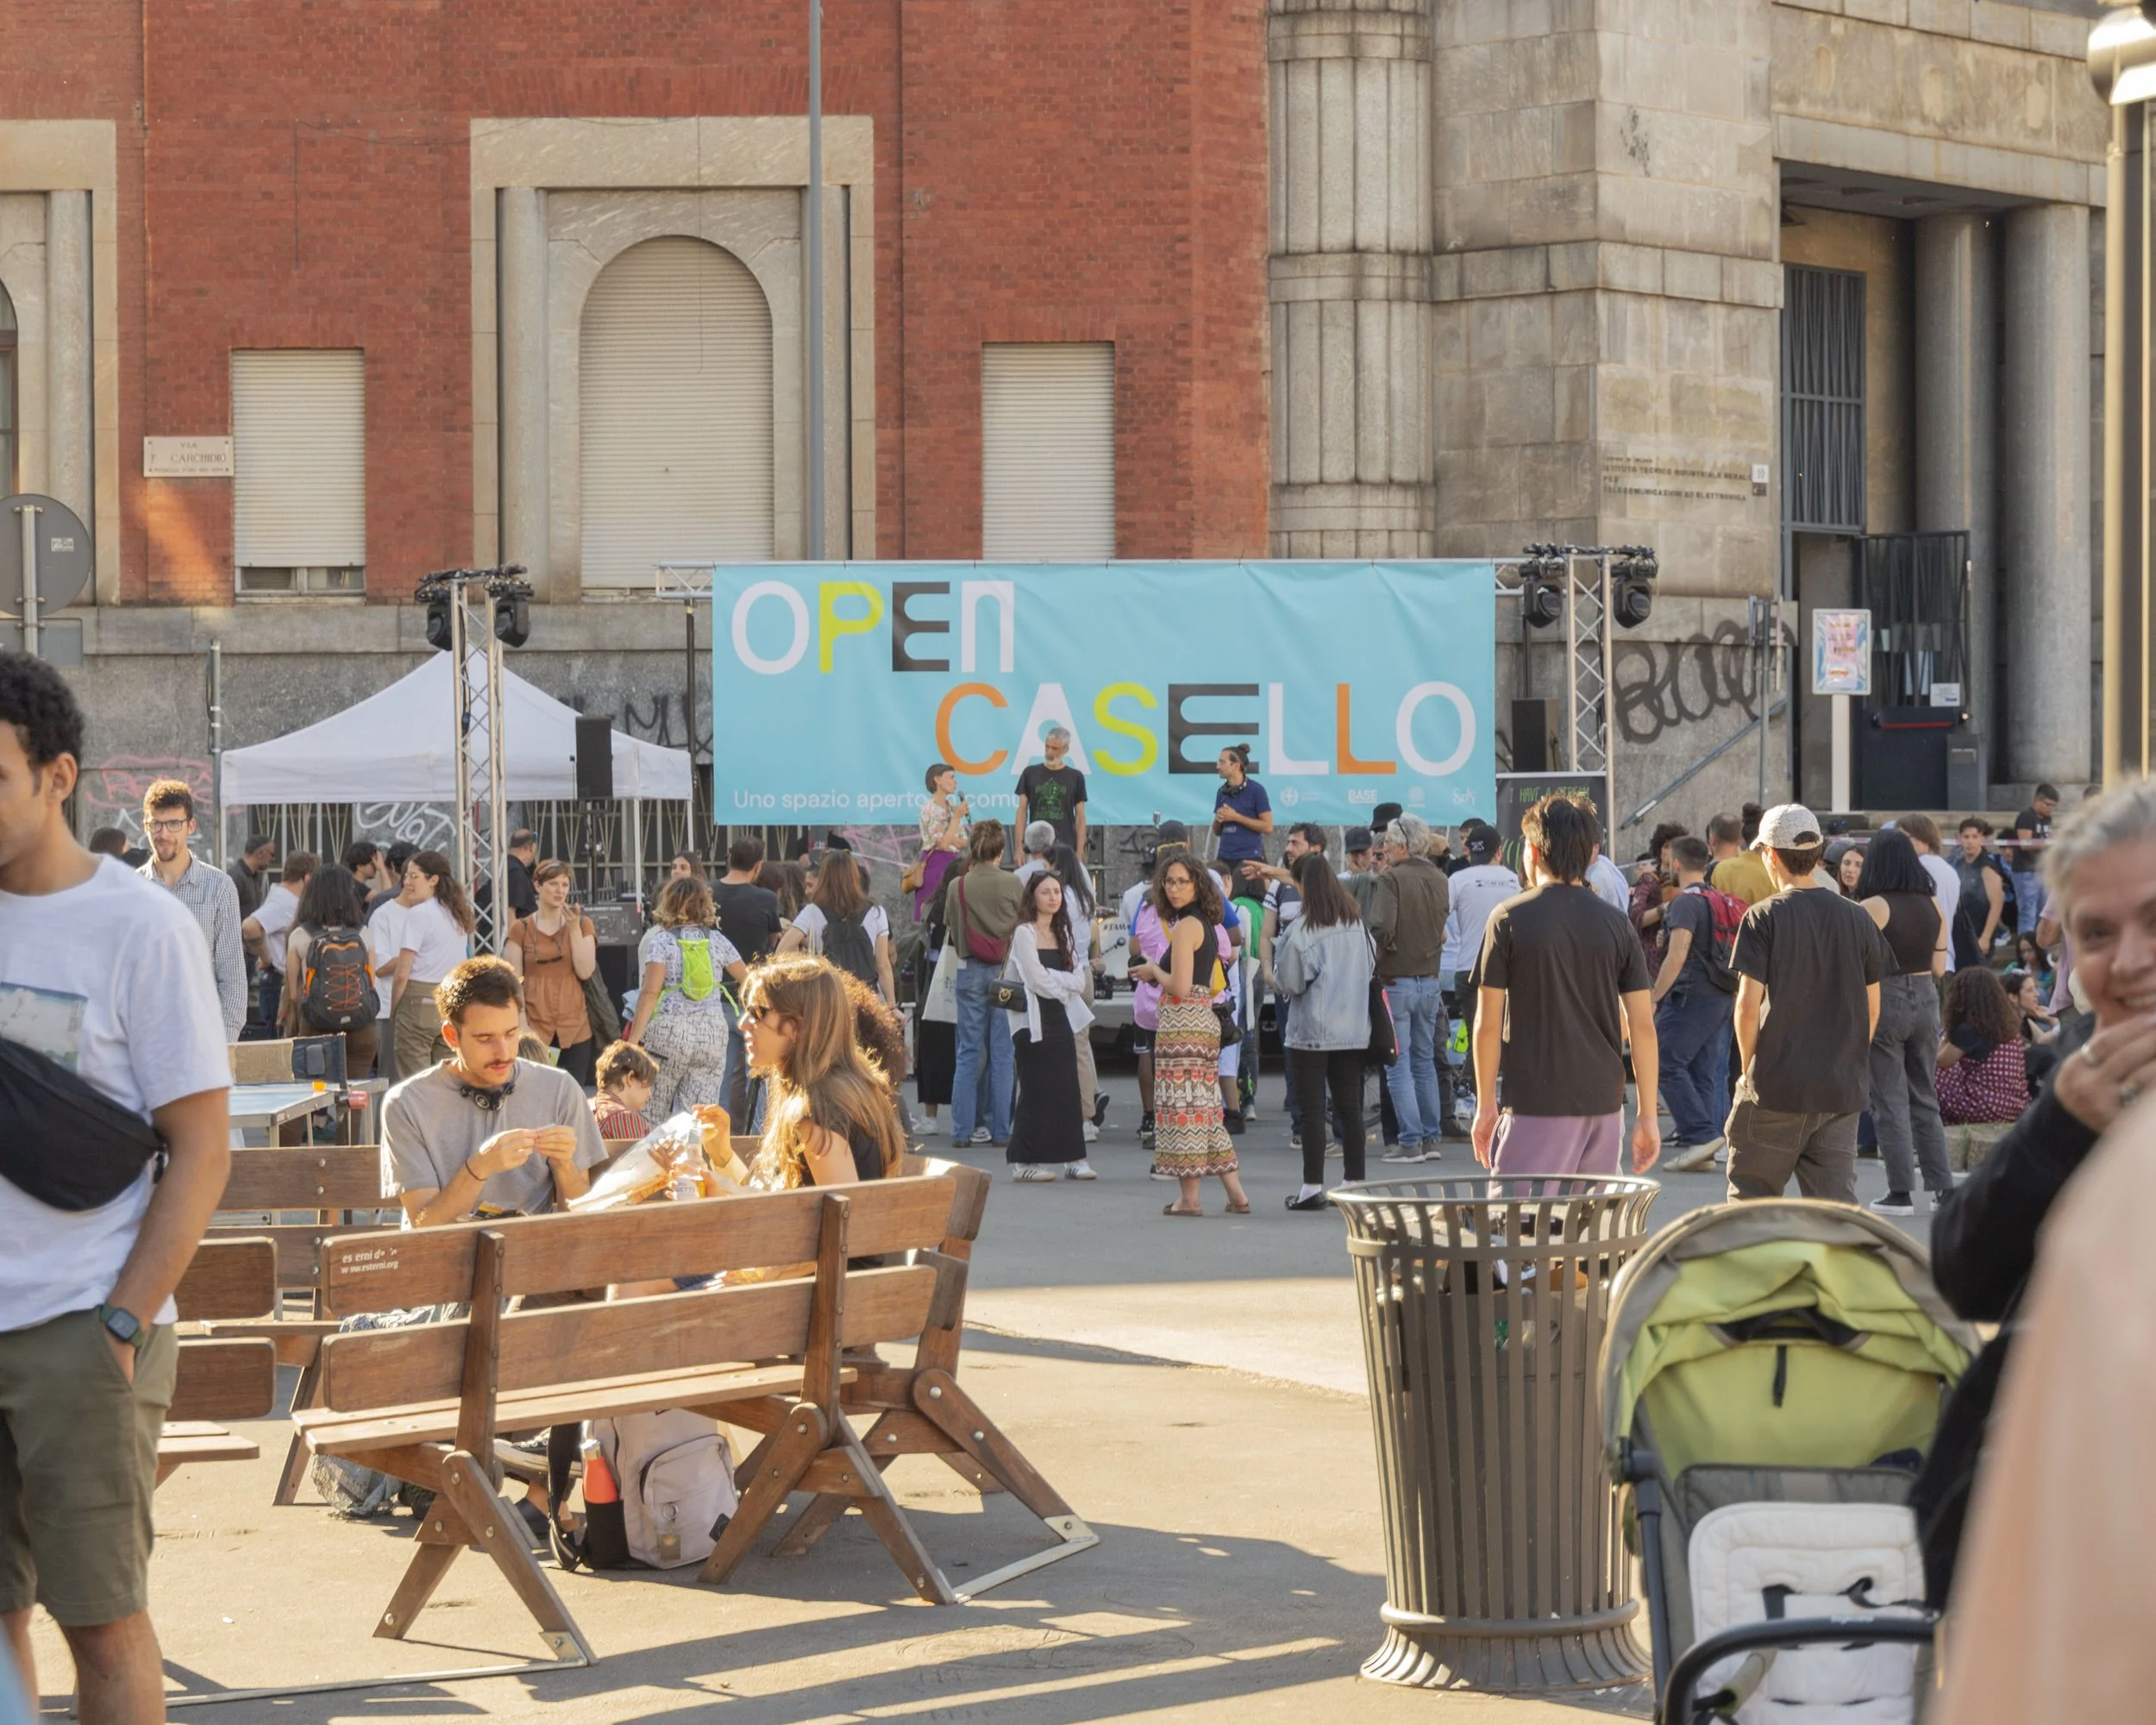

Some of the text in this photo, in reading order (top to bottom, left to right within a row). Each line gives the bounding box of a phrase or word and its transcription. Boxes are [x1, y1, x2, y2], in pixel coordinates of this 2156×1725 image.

[935, 681, 1476, 776] CASELLO
[734, 790, 775, 808] Uno
[781, 788, 850, 812] spazio
[856, 791, 927, 812] aperto
[1348, 789, 1378, 802] BASE
